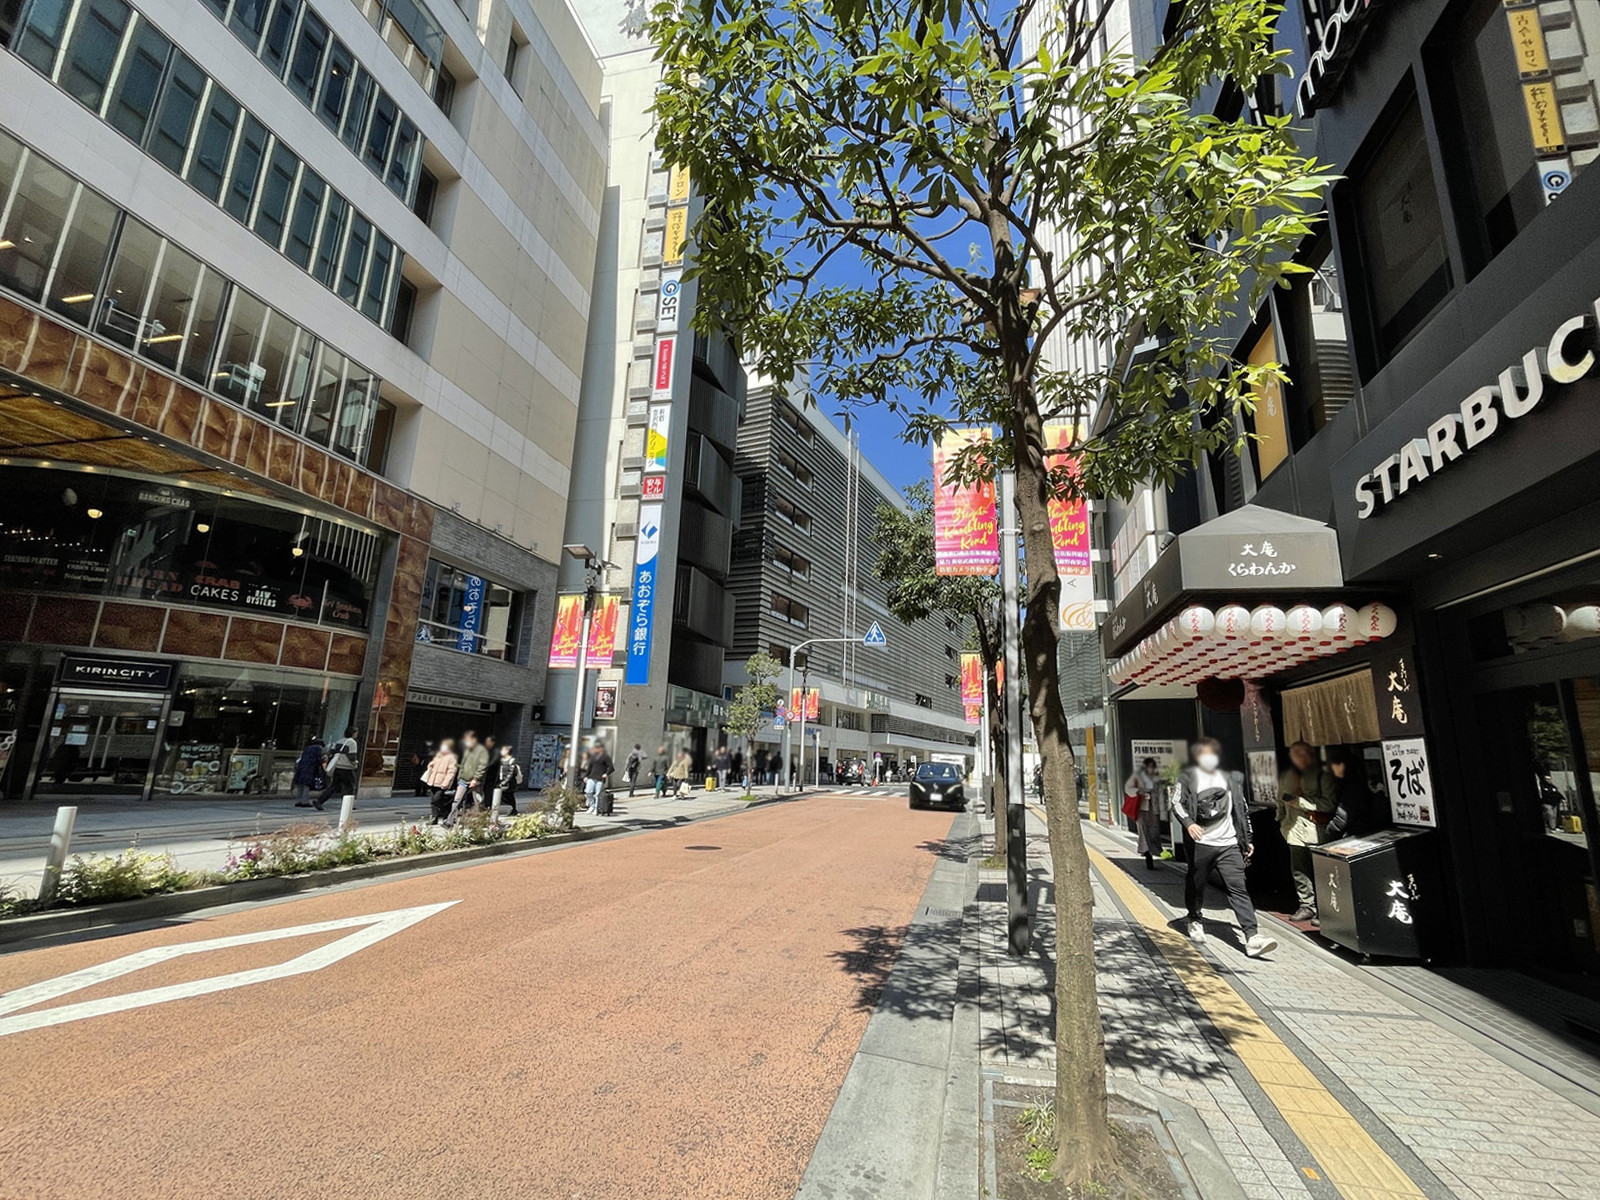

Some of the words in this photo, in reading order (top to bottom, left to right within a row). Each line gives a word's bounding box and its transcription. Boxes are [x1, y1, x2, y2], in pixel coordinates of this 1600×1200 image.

[1355, 297, 1600, 520] STARBUC
[1240, 540, 1278, 558] 大庵
[1227, 562, 1296, 577] くらわんか
[190, 584, 240, 602] CAKES
[245, 595, 277, 608] OYSTERS
[254, 589, 273, 599] RAW
[633, 570, 652, 656] あおぞら銀行
[75, 666, 118, 676] KIRIN
[120, 669, 156, 678] CITY
[411, 693, 449, 704] PARKING
[1387, 670, 1408, 724] 大庵
[1389, 756, 1426, 799] そば
[1384, 879, 1413, 924] 大庵
